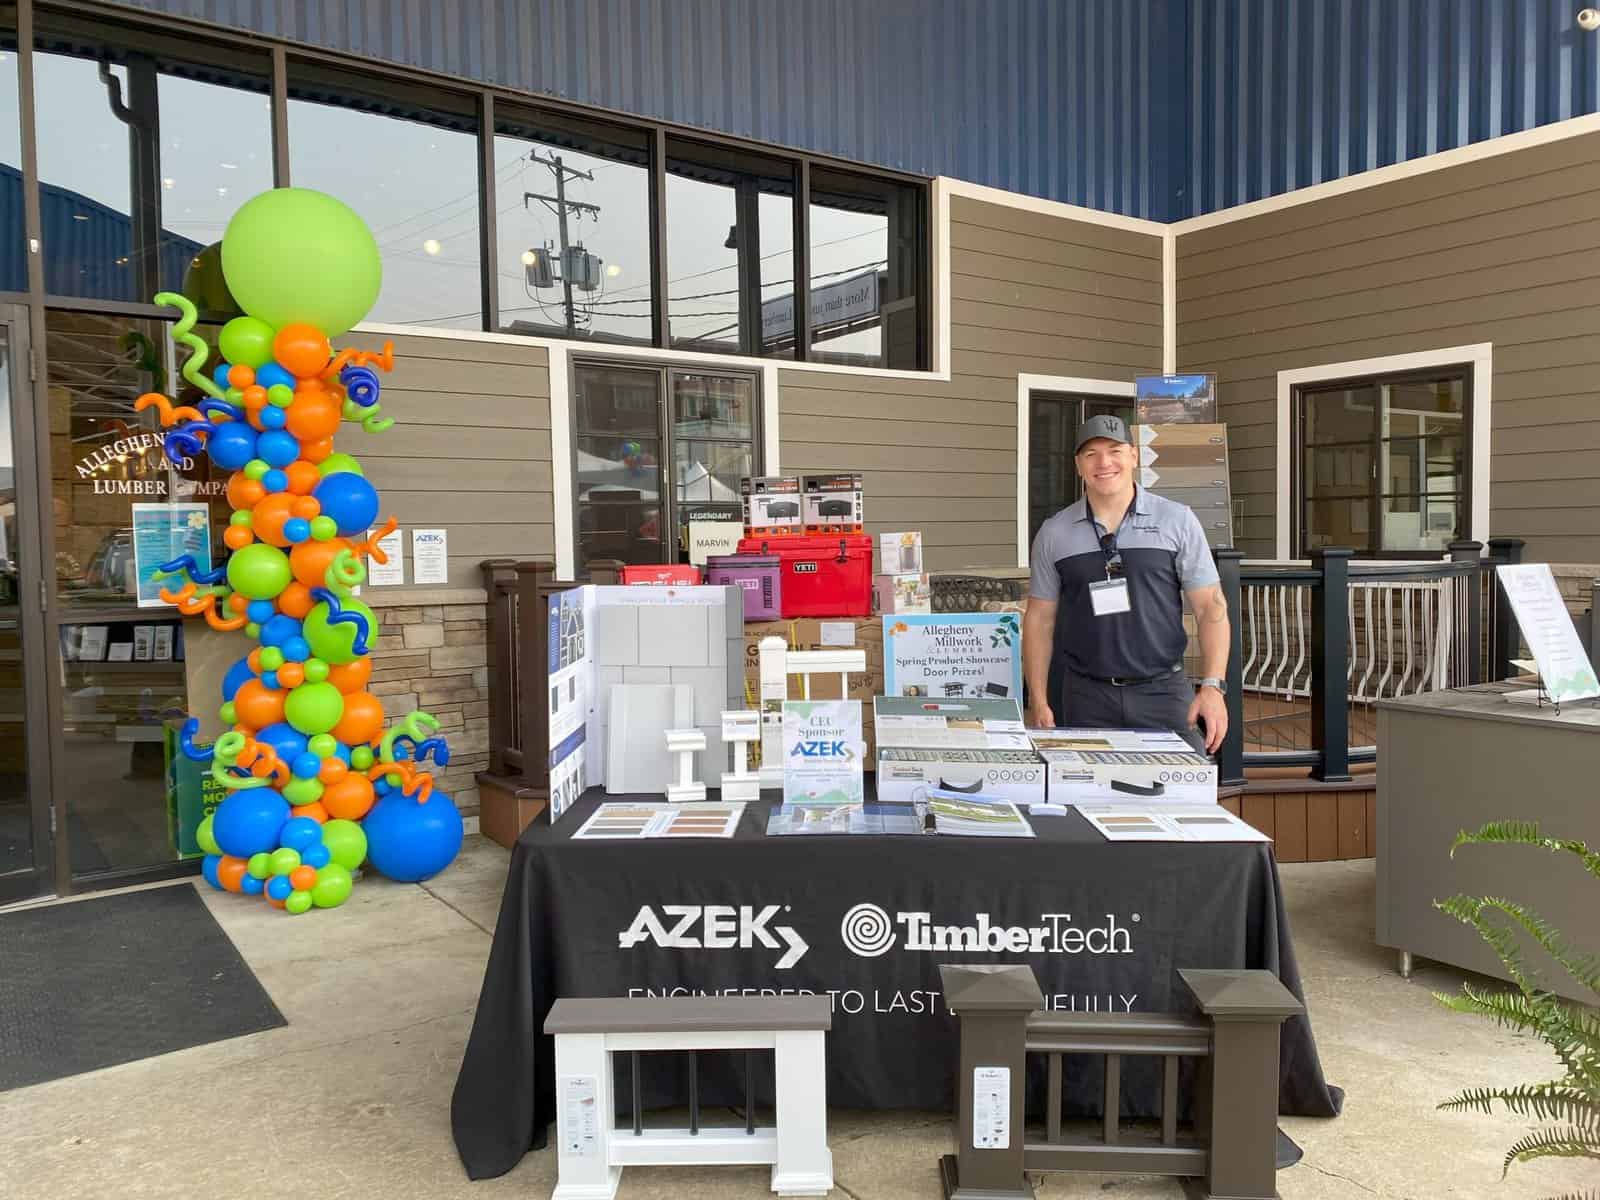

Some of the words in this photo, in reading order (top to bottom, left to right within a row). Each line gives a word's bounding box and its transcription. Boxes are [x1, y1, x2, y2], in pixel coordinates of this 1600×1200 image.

[74, 431, 169, 479] ALLEGHEN
[93, 479, 168, 495] LUMBER
[689, 512, 732, 521] LEGENDARY
[696, 539, 730, 548] MARVIN
[794, 563, 816, 572] YETI
[922, 624, 975, 638] Allegheny
[935, 635, 983, 647] Millwork
[895, 657, 926, 667] Spring
[928, 656, 964, 665] Product
[966, 655, 1010, 664] Showcase
[923, 667, 948, 677] Door
[951, 666, 985, 676] Prizes!
[798, 728, 846, 739] Sponsor
[790, 740, 848, 757] AZEK
[618, 904, 782, 949] AZEK
[896, 911, 1134, 954] TimberTech
[825, 989, 865, 1014] TO
[874, 989, 941, 1015] LAST
